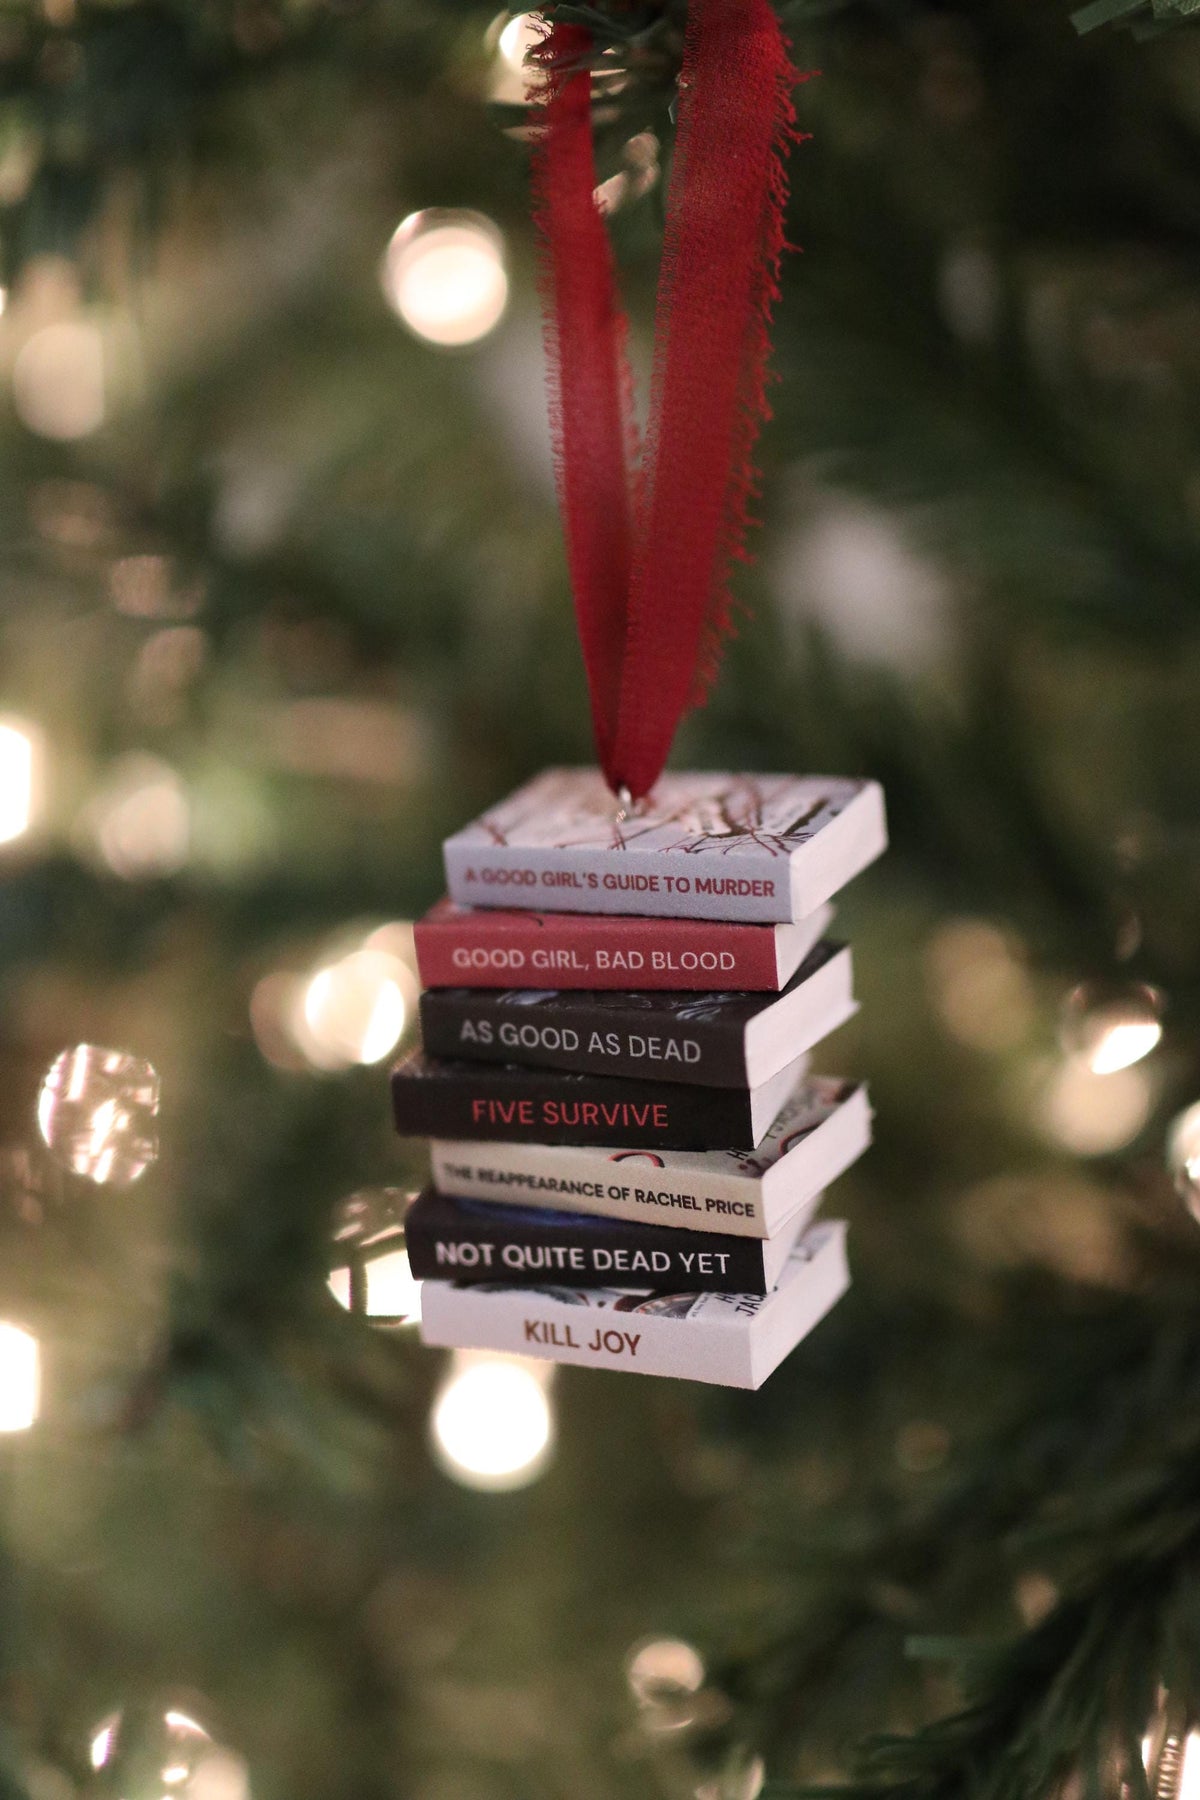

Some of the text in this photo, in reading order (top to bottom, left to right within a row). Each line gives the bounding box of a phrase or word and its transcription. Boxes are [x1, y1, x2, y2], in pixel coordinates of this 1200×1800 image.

[465, 868, 775, 897] A GOOD GIRL'S GUIDE TO MURDER
[453, 948, 735, 971] GOOD GIRL, BAD BLOOD
[460, 1019, 700, 1063] AS GOOD AS DEAD
[472, 1100, 669, 1127] FIVE SURVIVE
[443, 1163, 755, 1218] THE REAPPEARANCE OF RACHEL PRICE
[435, 1241, 730, 1274] NOT QUITE DEAD YET
[525, 1319, 640, 1357] KILL JOY
